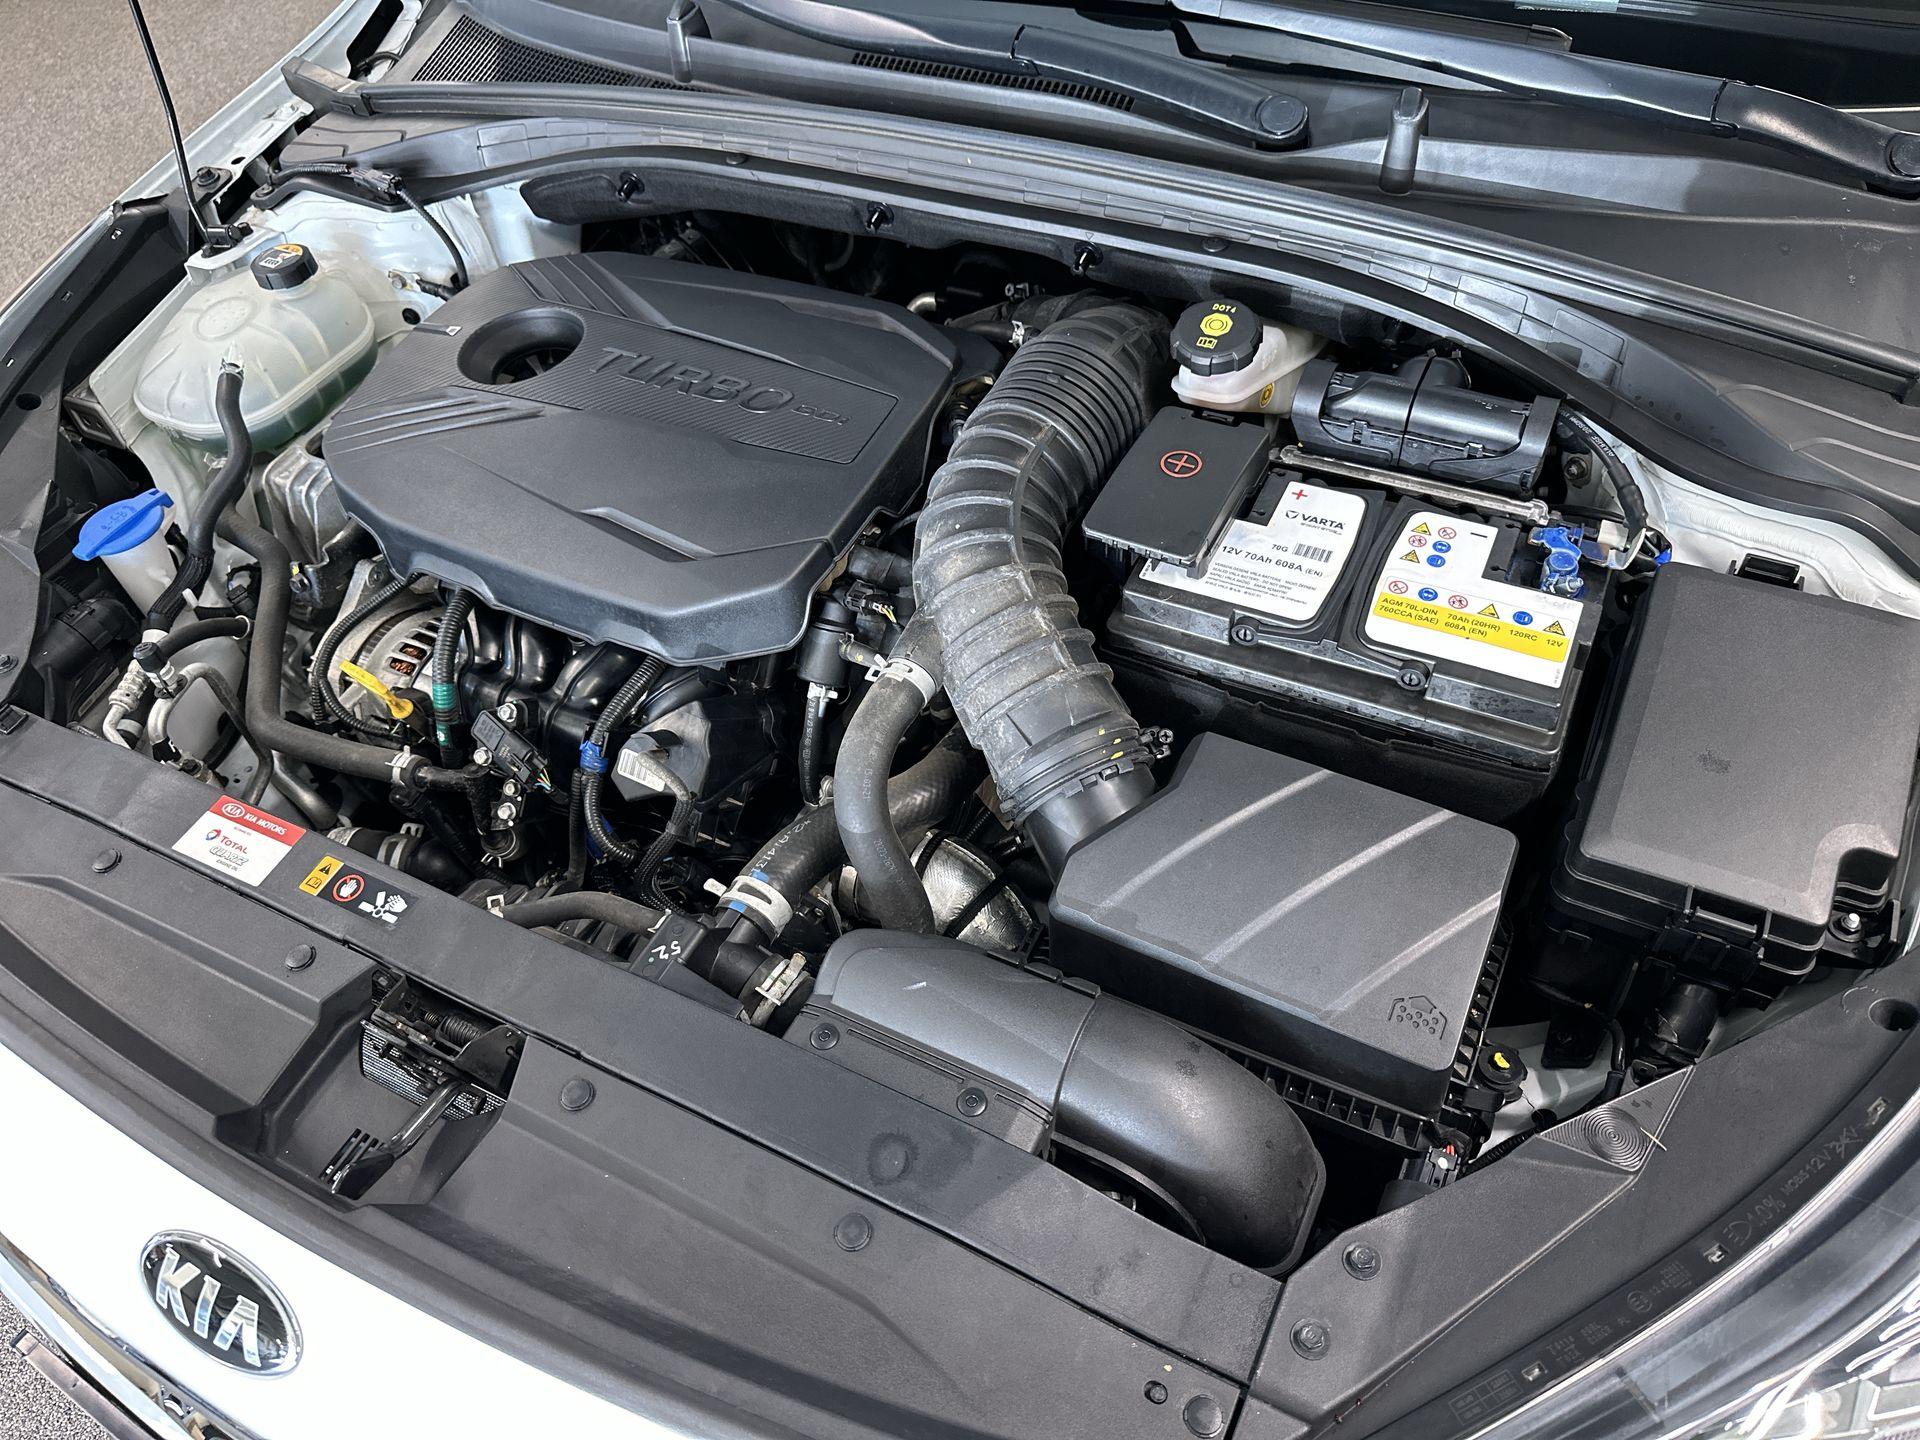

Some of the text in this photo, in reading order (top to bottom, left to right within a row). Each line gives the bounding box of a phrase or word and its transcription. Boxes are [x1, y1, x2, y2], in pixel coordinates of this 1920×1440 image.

[1212, 303, 1237, 313] DOT4
[589, 347, 795, 413] TURBO
[1301, 513, 1344, 530] VARTA
[1222, 545, 1323, 577] 12V 70Ah 608A (EN)
[1379, 605, 1488, 637] 760CCA (SAE) 608A (EN)
[1382, 597, 1564, 648] AGM 70L-DIN 70Ah (20HR) 120RC 12V
[244, 813, 257, 823] KIA
[257, 819, 288, 835] MOTORS
[220, 836, 248, 854] TOTAL
[156, 1246, 262, 1367] KIA
